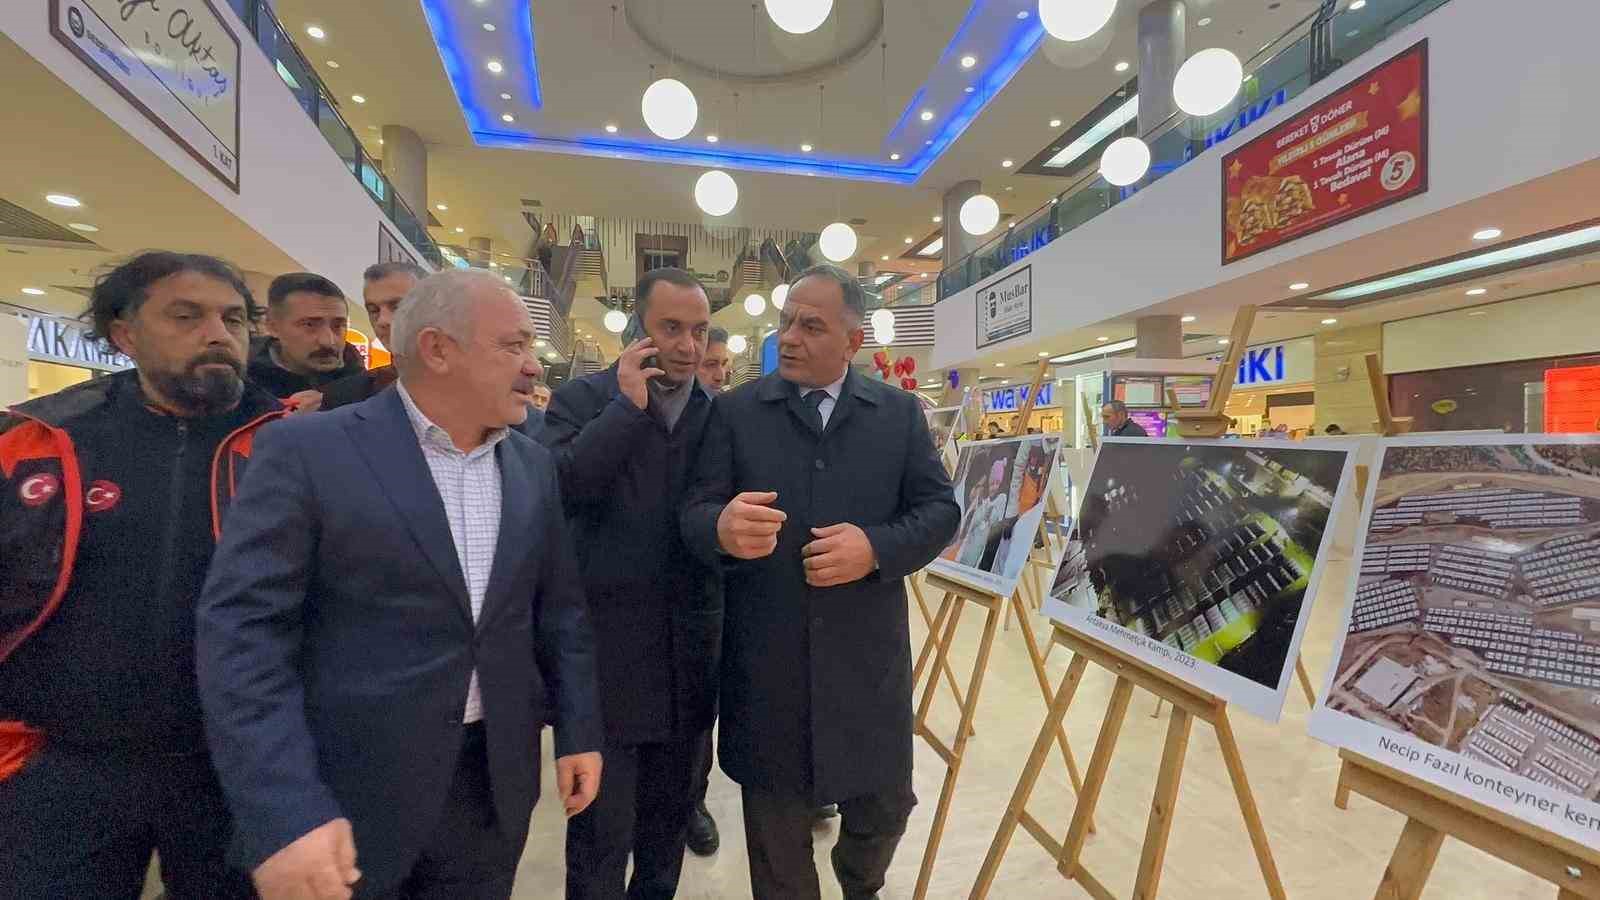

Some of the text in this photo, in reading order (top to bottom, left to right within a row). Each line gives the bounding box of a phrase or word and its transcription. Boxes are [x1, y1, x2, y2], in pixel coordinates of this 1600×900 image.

[1276, 100, 1353, 149] BEREKET DÖNER
[1336, 149, 1366, 169] Alana
[1390, 160, 1405, 181] 5
[1378, 736, 1420, 762] Necip
[1424, 751, 1459, 777] Fazıl
[1463, 767, 1560, 813] konteyner
